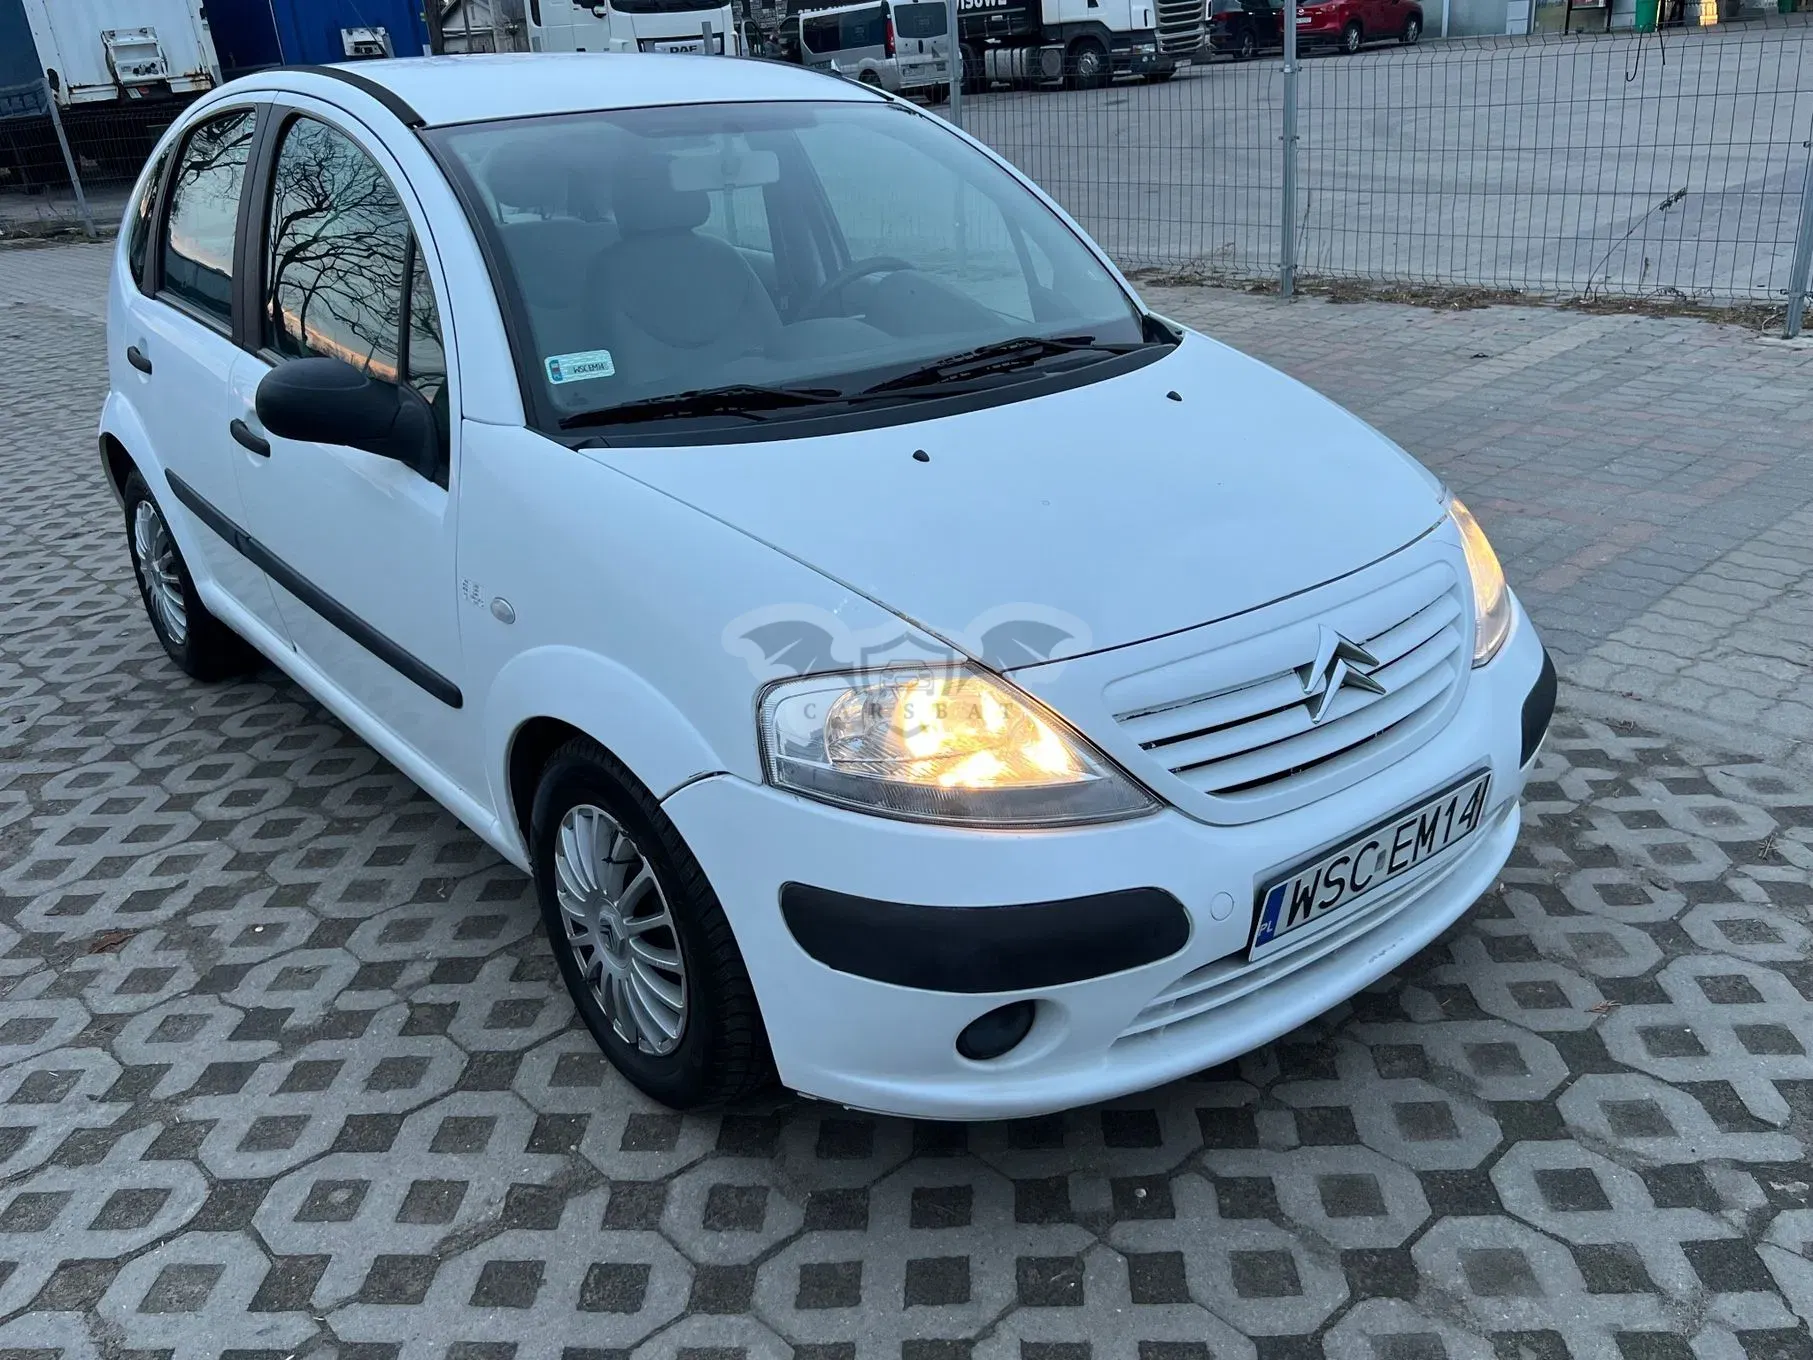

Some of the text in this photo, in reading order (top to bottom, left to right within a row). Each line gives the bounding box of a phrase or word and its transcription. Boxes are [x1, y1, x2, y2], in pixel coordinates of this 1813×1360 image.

[669, 45, 698, 54] DAF
[1286, 781, 1484, 928] WSC EM14
[1258, 919, 1274, 938] PL
